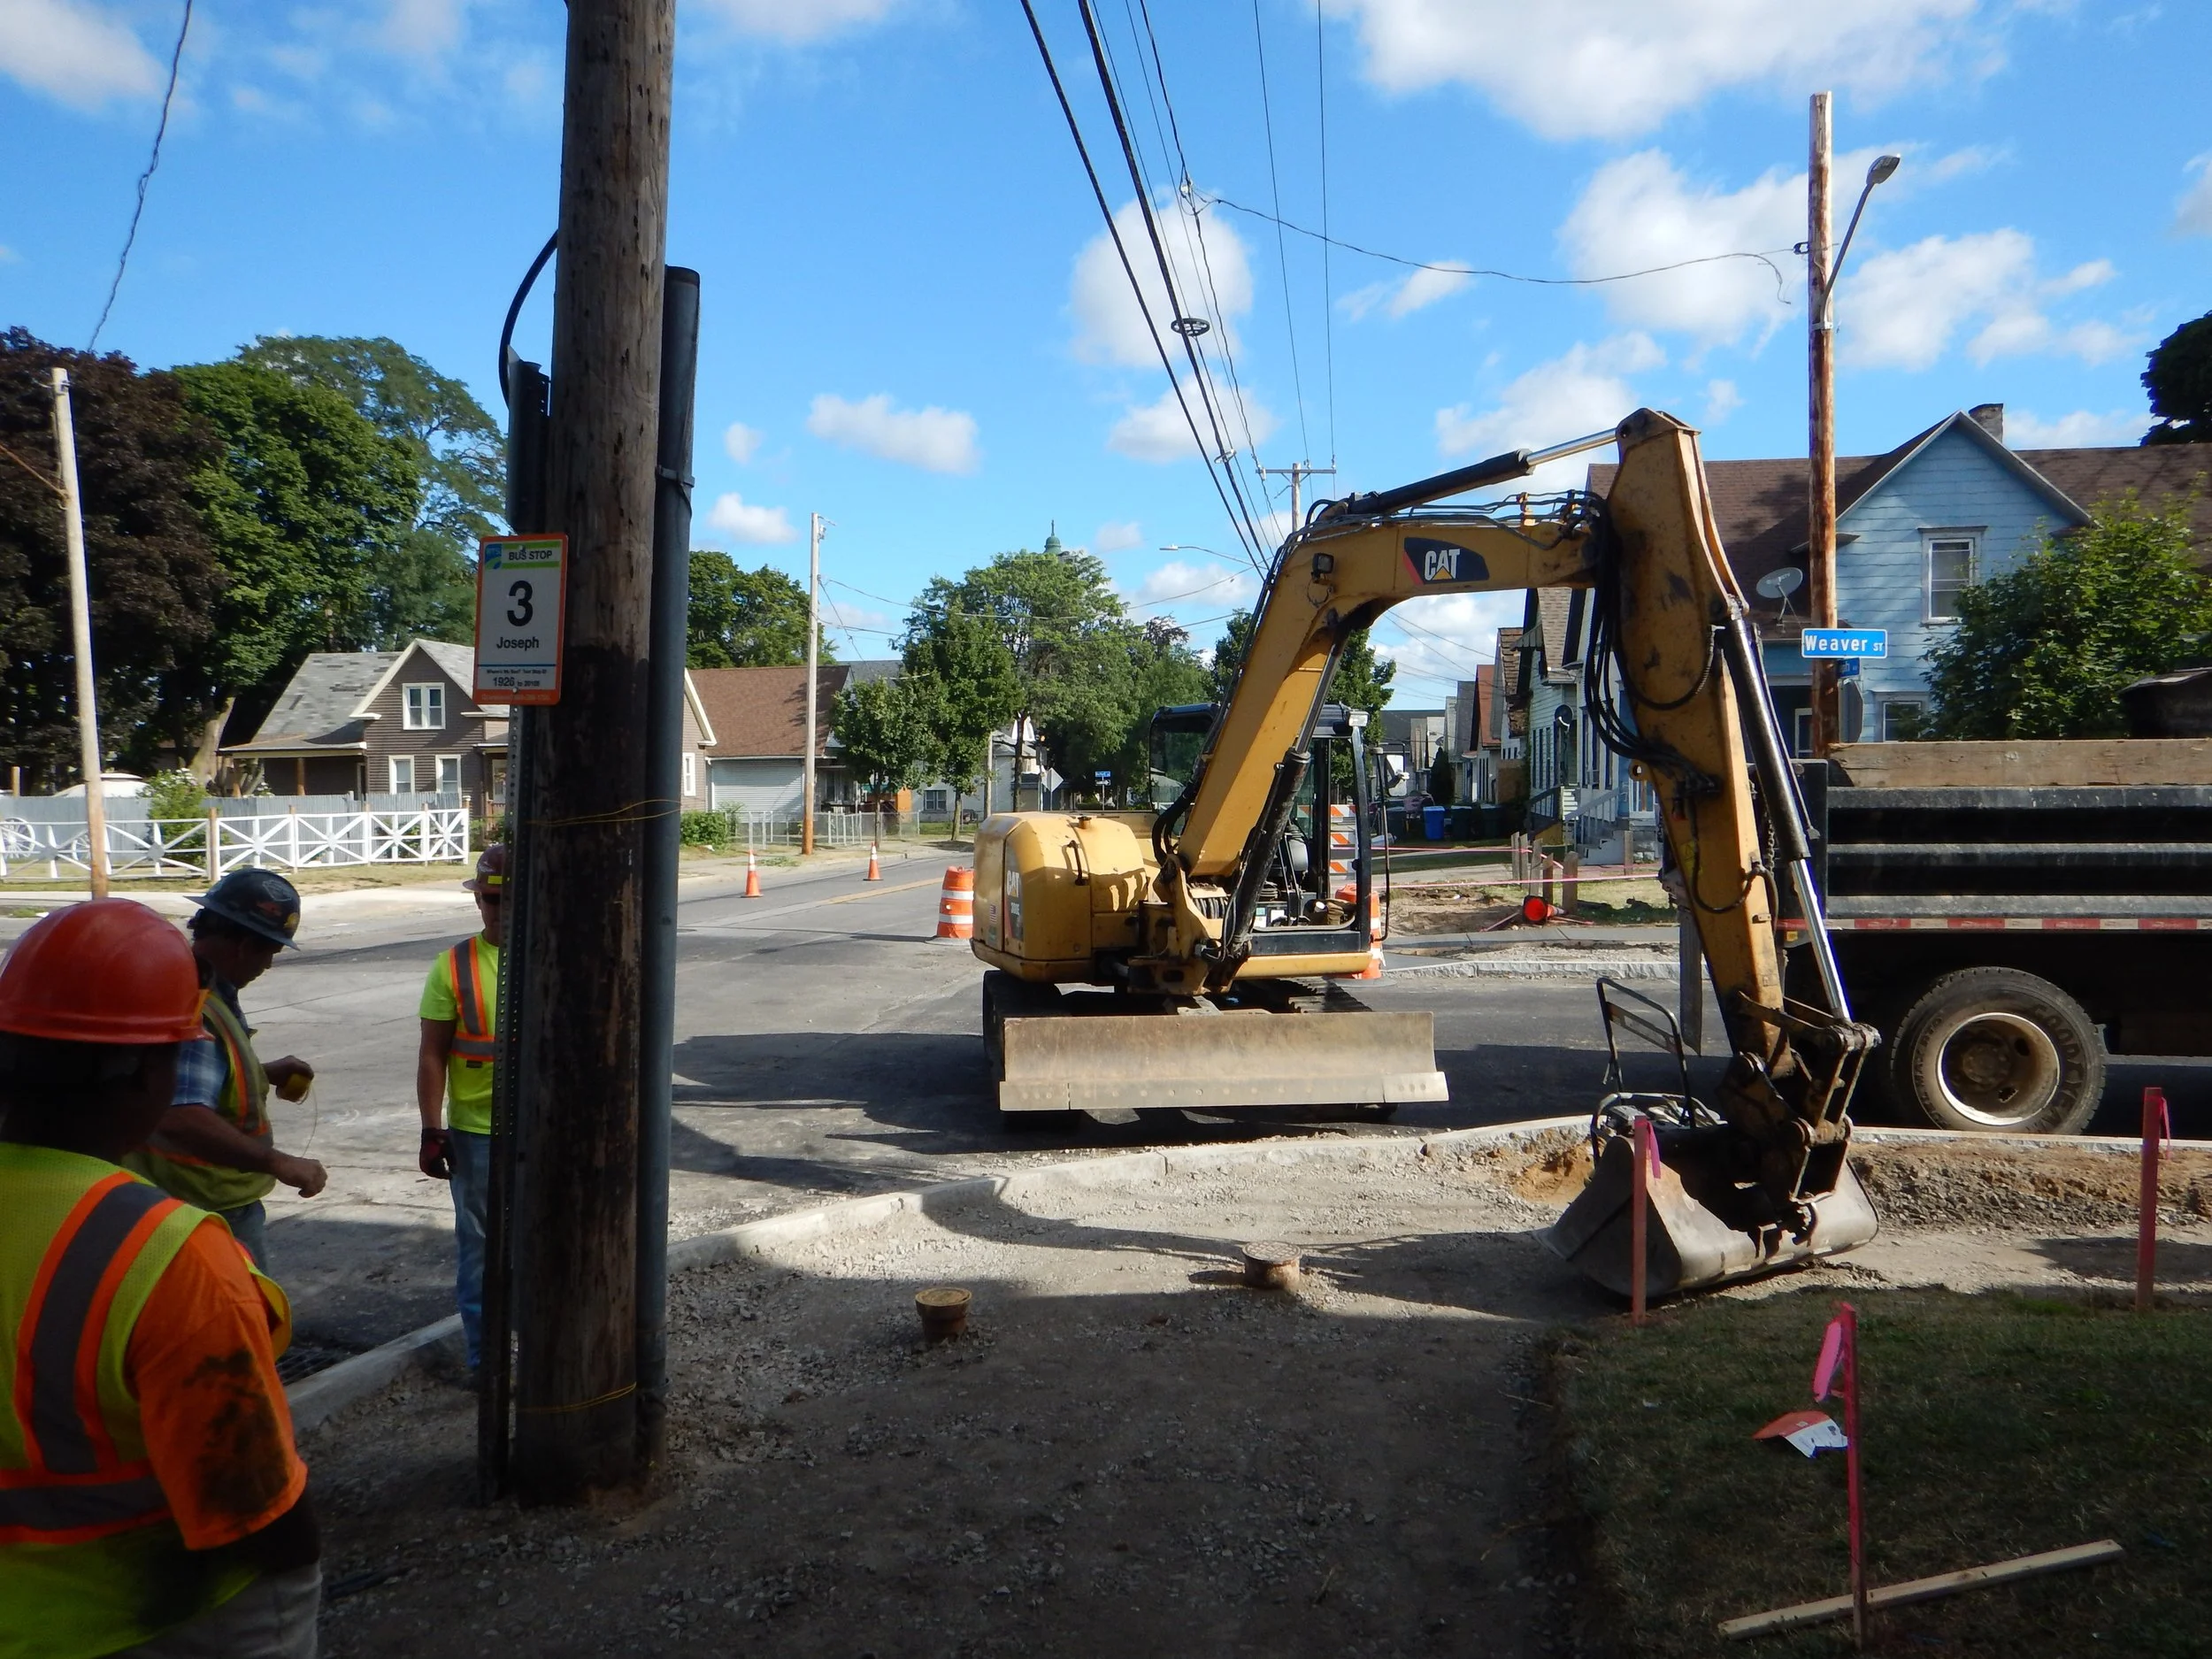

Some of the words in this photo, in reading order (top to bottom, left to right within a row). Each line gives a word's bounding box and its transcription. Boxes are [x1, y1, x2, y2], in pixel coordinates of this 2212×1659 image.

[508, 551, 526, 561] BUS
[528, 549, 553, 560] STOP
[1424, 549, 1461, 581] CAT
[507, 580, 534, 627] 3
[496, 636, 540, 651] Joseph
[1805, 634, 1868, 652] Weaver
[1872, 642, 1884, 652] ST
[493, 676, 515, 687] 1926
[1007, 871, 1020, 898] CAT
